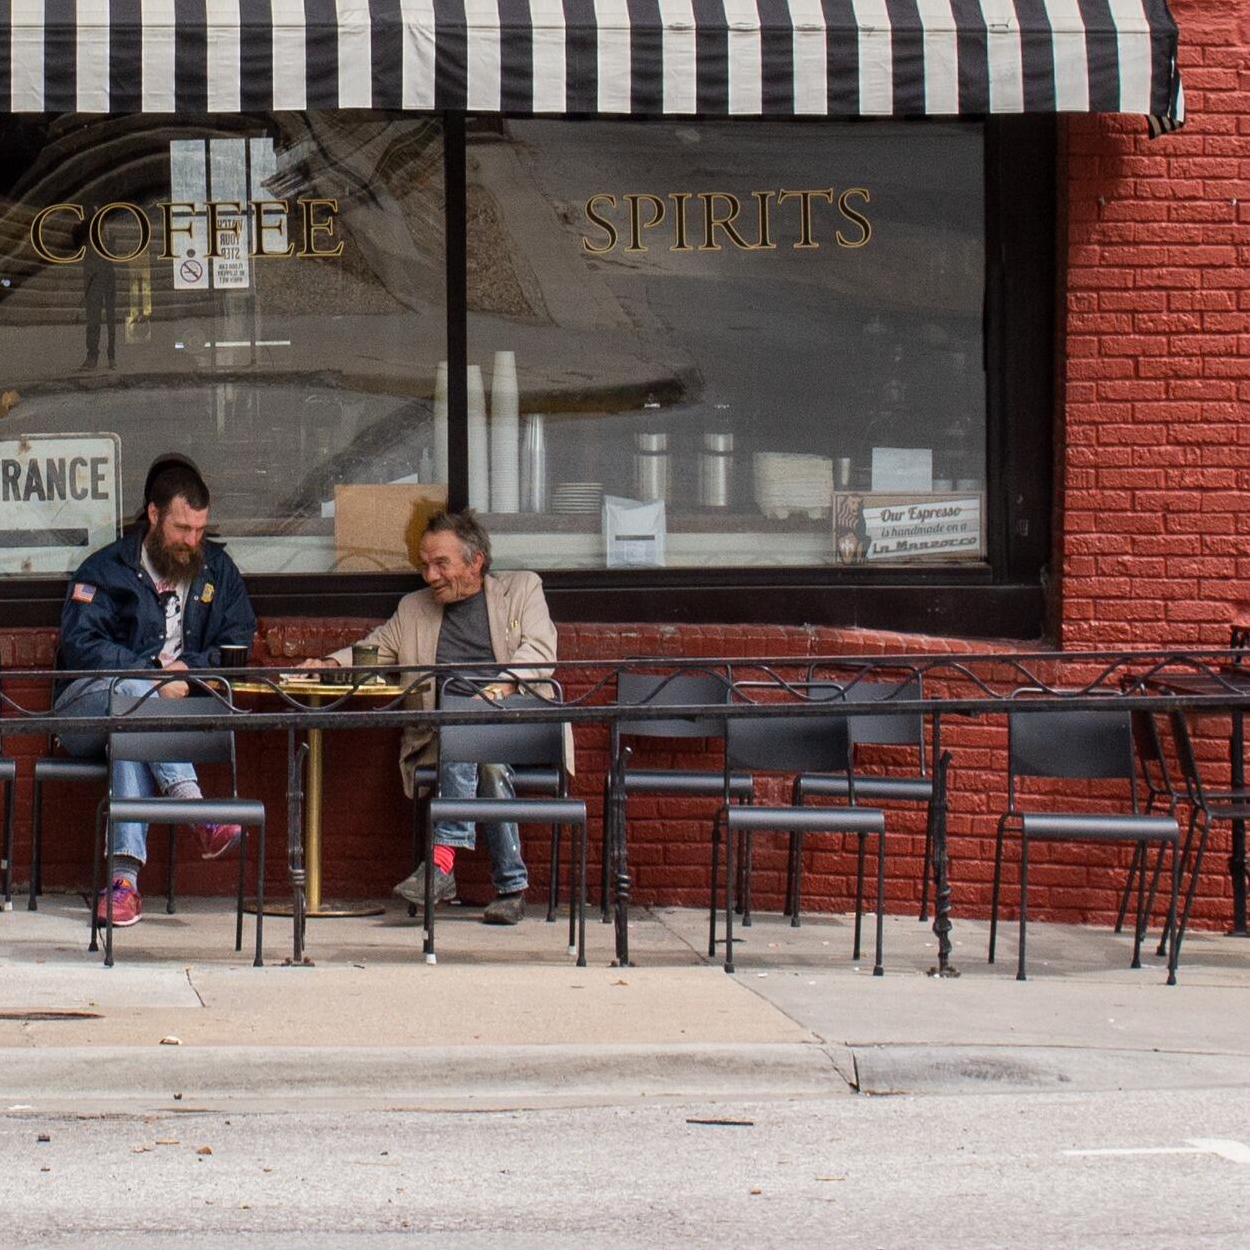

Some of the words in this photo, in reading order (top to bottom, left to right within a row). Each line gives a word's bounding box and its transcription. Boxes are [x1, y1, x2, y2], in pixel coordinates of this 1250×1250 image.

[30, 199, 345, 263] COFFEE
[582, 187, 872, 254] SPIRITS
[880, 509, 905, 523] Our
[908, 506, 962, 523] Espresso
[881, 527, 890, 537] is
[891, 523, 943, 537] handmade
[946, 524, 959, 532] on
